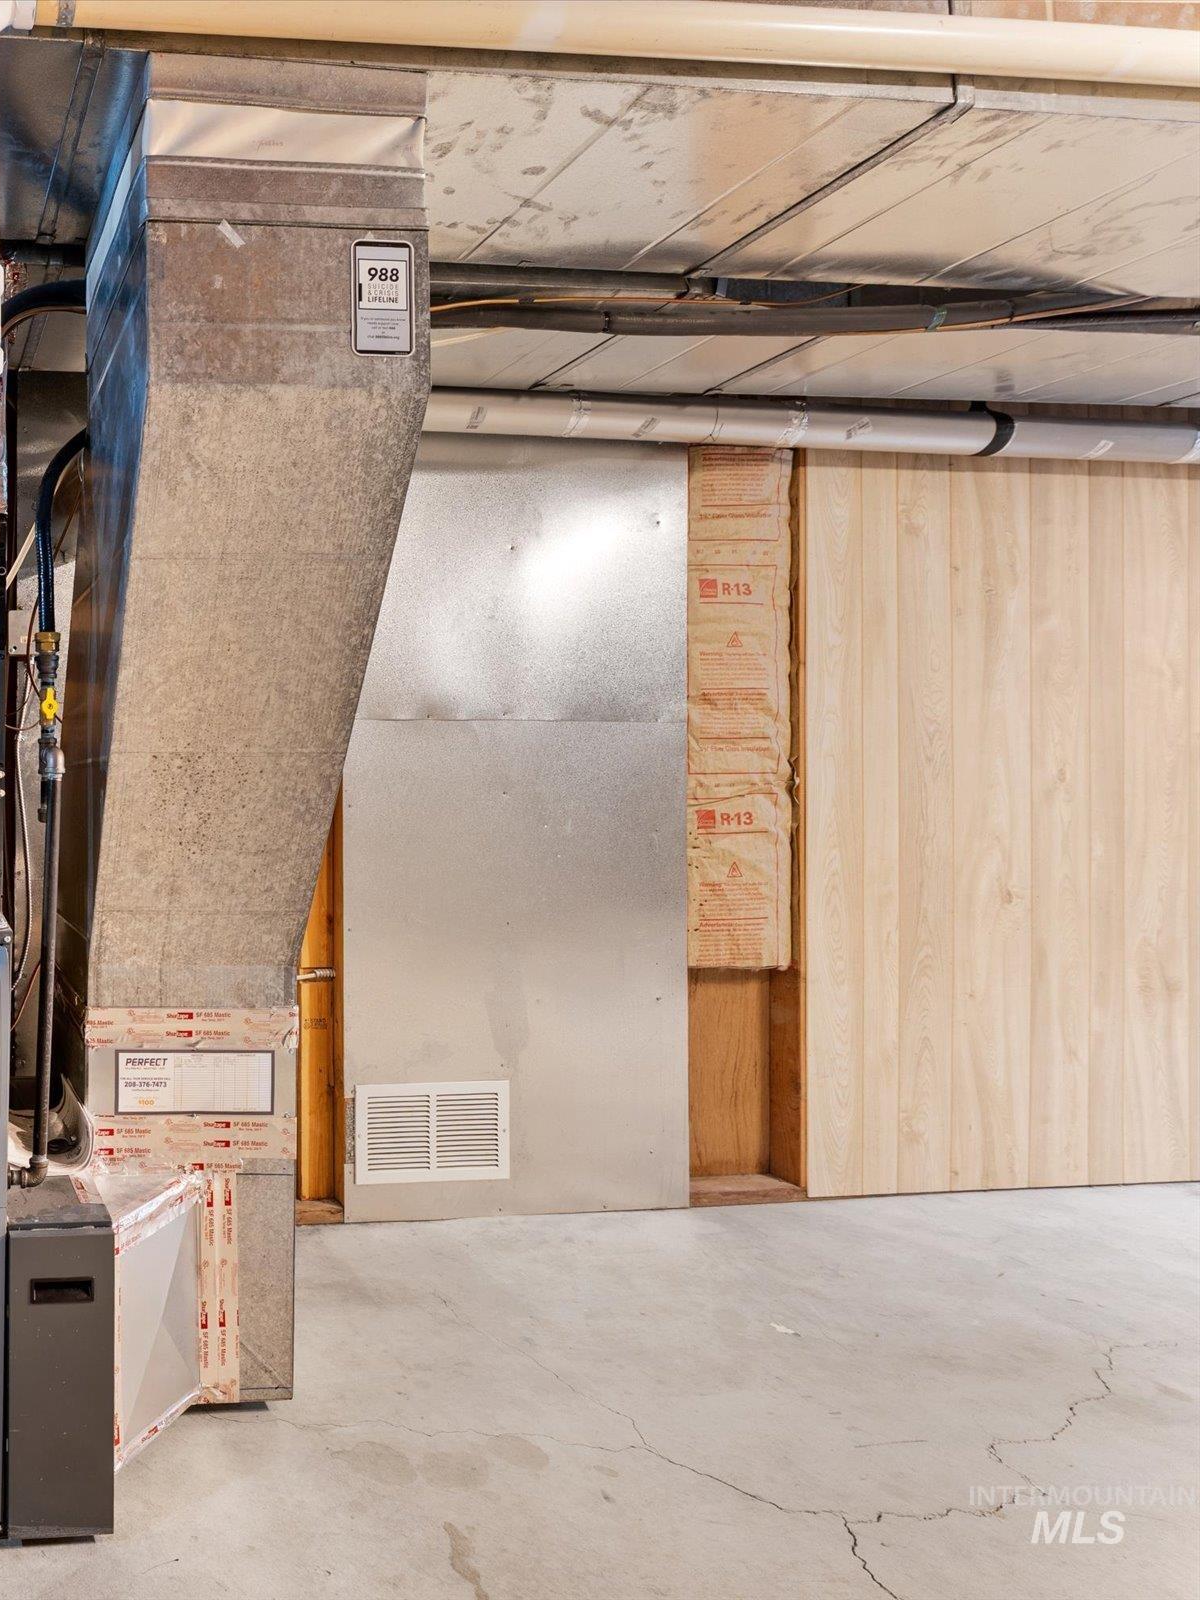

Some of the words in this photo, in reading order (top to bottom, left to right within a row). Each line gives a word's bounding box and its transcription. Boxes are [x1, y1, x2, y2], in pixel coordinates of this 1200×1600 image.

[368, 267, 399, 282] 988
[722, 583, 752, 596] R-13
[720, 811, 753, 826] R-13
[125, 1058, 168, 1067] PERFECT
